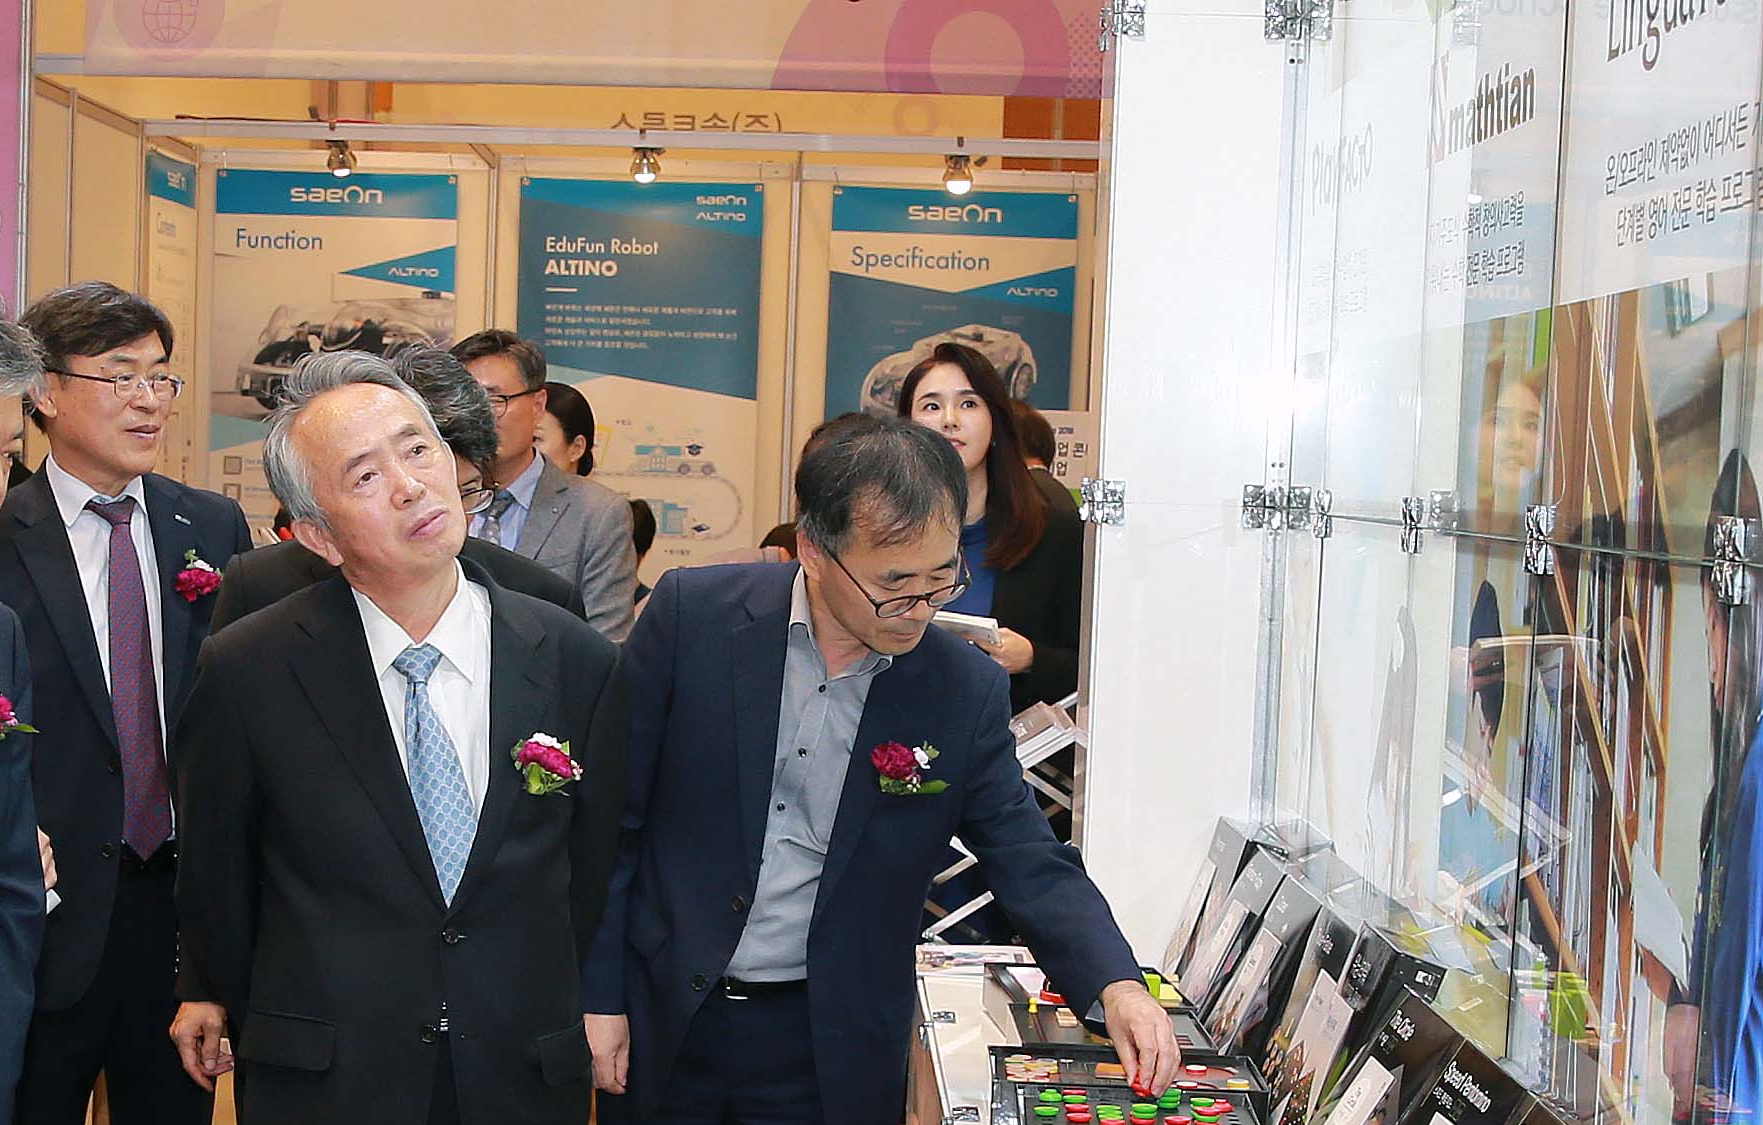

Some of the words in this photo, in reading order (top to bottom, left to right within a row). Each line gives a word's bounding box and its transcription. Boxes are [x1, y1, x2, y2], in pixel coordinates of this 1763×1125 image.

[1605, 137, 1657, 195] 온/오프라인
[1659, 121, 1699, 175] 제약없이
[1703, 102, 1748, 160] 어디서든
[1616, 204, 1645, 247] 단계별
[1648, 192, 1668, 239] 영어
[1670, 185, 1692, 232] 전문
[1695, 180, 1717, 225] 학습
[236, 228, 323, 250] Function
[545, 236, 605, 254] EduFun
[611, 238, 659, 255] Robot
[544, 259, 618, 277] ALTINO
[851, 246, 991, 272] Specification
